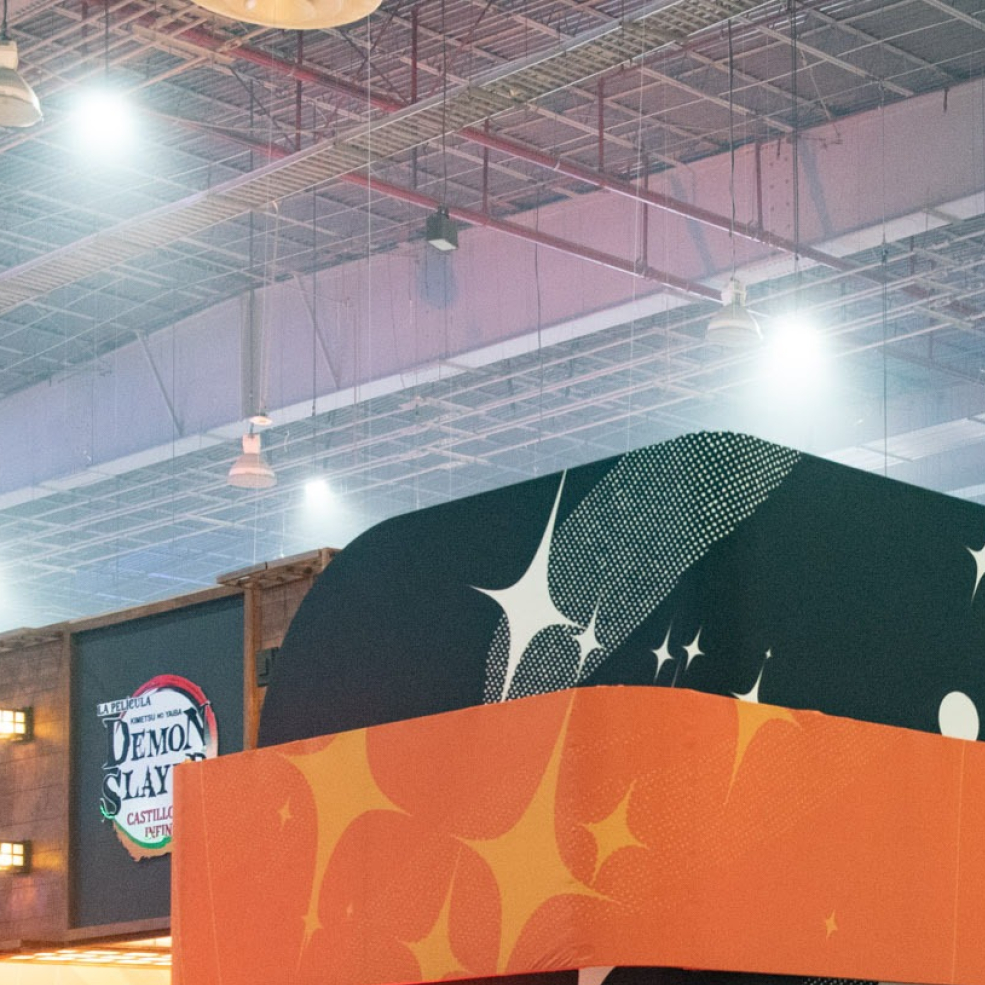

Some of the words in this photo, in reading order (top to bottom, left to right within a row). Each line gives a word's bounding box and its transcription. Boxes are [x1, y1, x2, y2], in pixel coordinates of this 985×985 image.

[98, 703, 109, 714] LA
[131, 713, 156, 724] KIMETSU
[166, 709, 183, 718] YAIBA
[102, 706, 208, 769] DEMON
